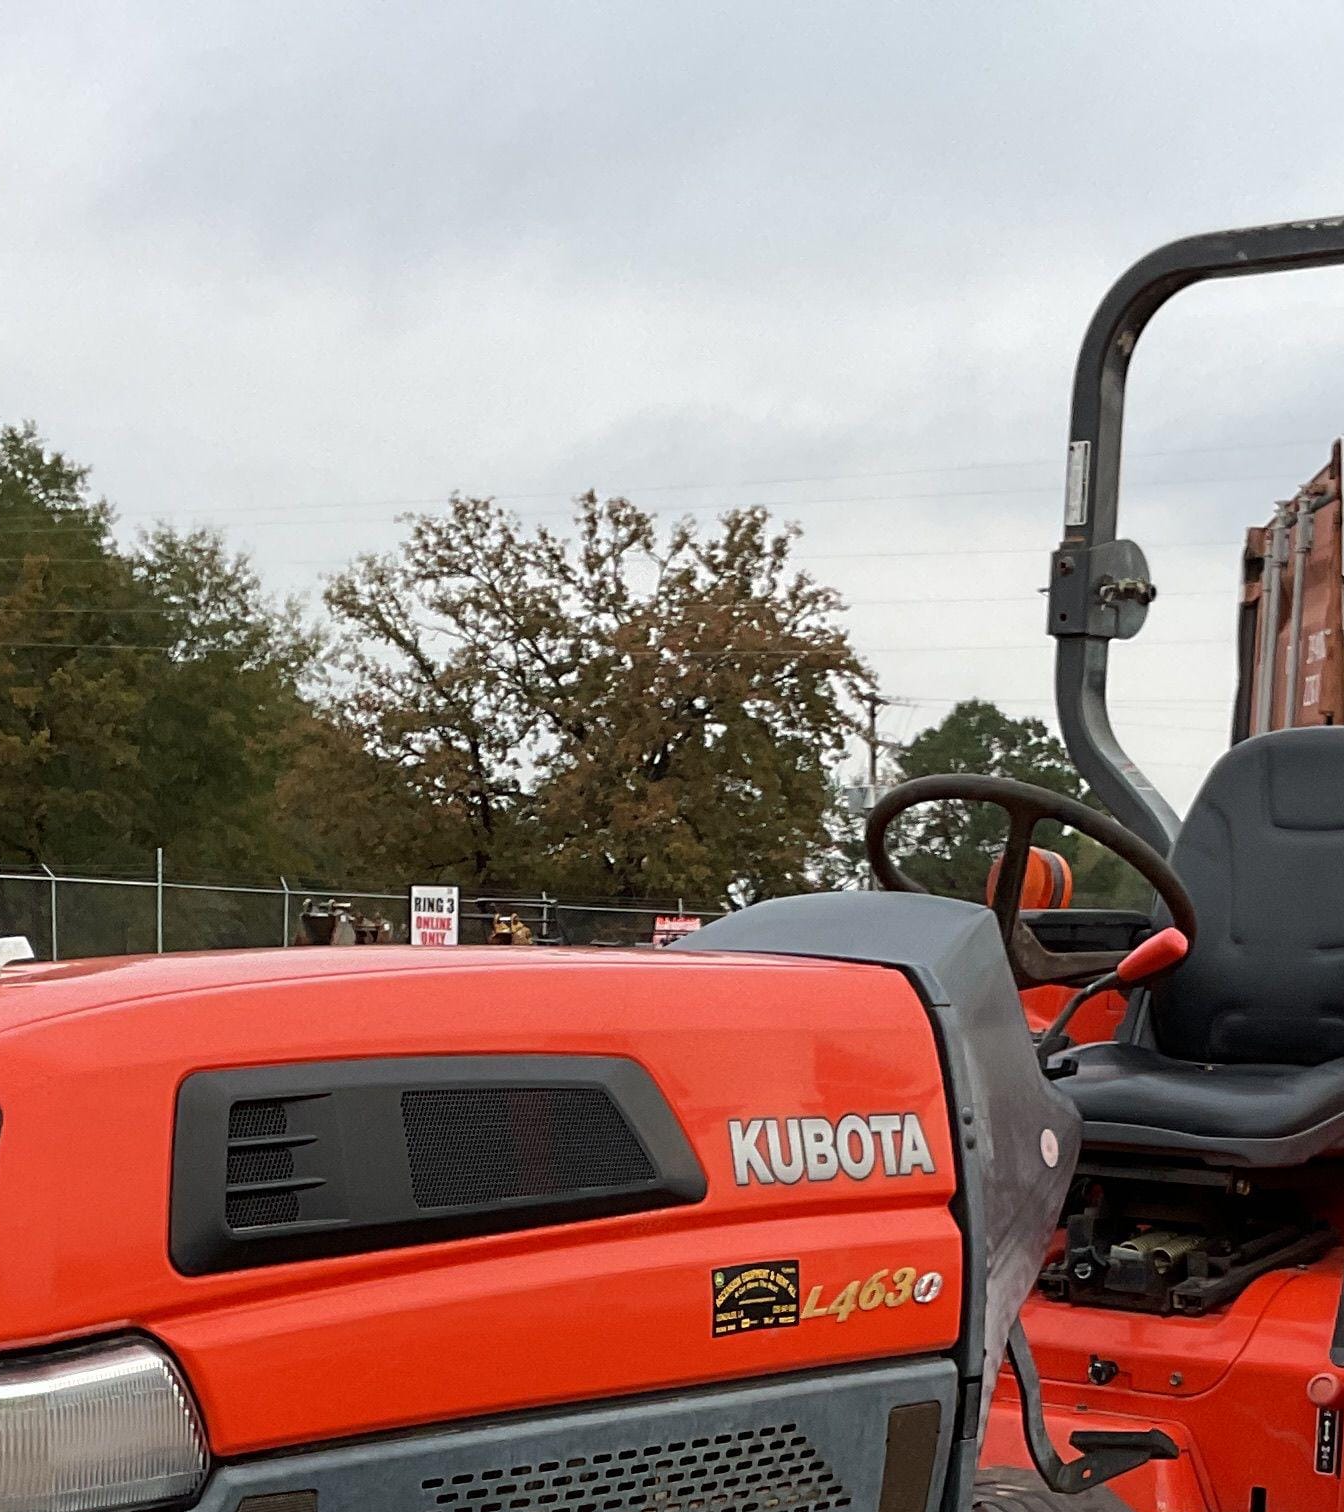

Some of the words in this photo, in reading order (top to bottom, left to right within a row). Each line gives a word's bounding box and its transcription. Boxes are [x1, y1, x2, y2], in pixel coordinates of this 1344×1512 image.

[414, 896, 444, 913] RING
[446, 897, 455, 914] 3
[416, 915, 453, 931] ONLINE
[421, 931, 447, 946] ONLY
[728, 1113, 936, 1186] KUBOTA
[799, 1266, 943, 1323] L4630
